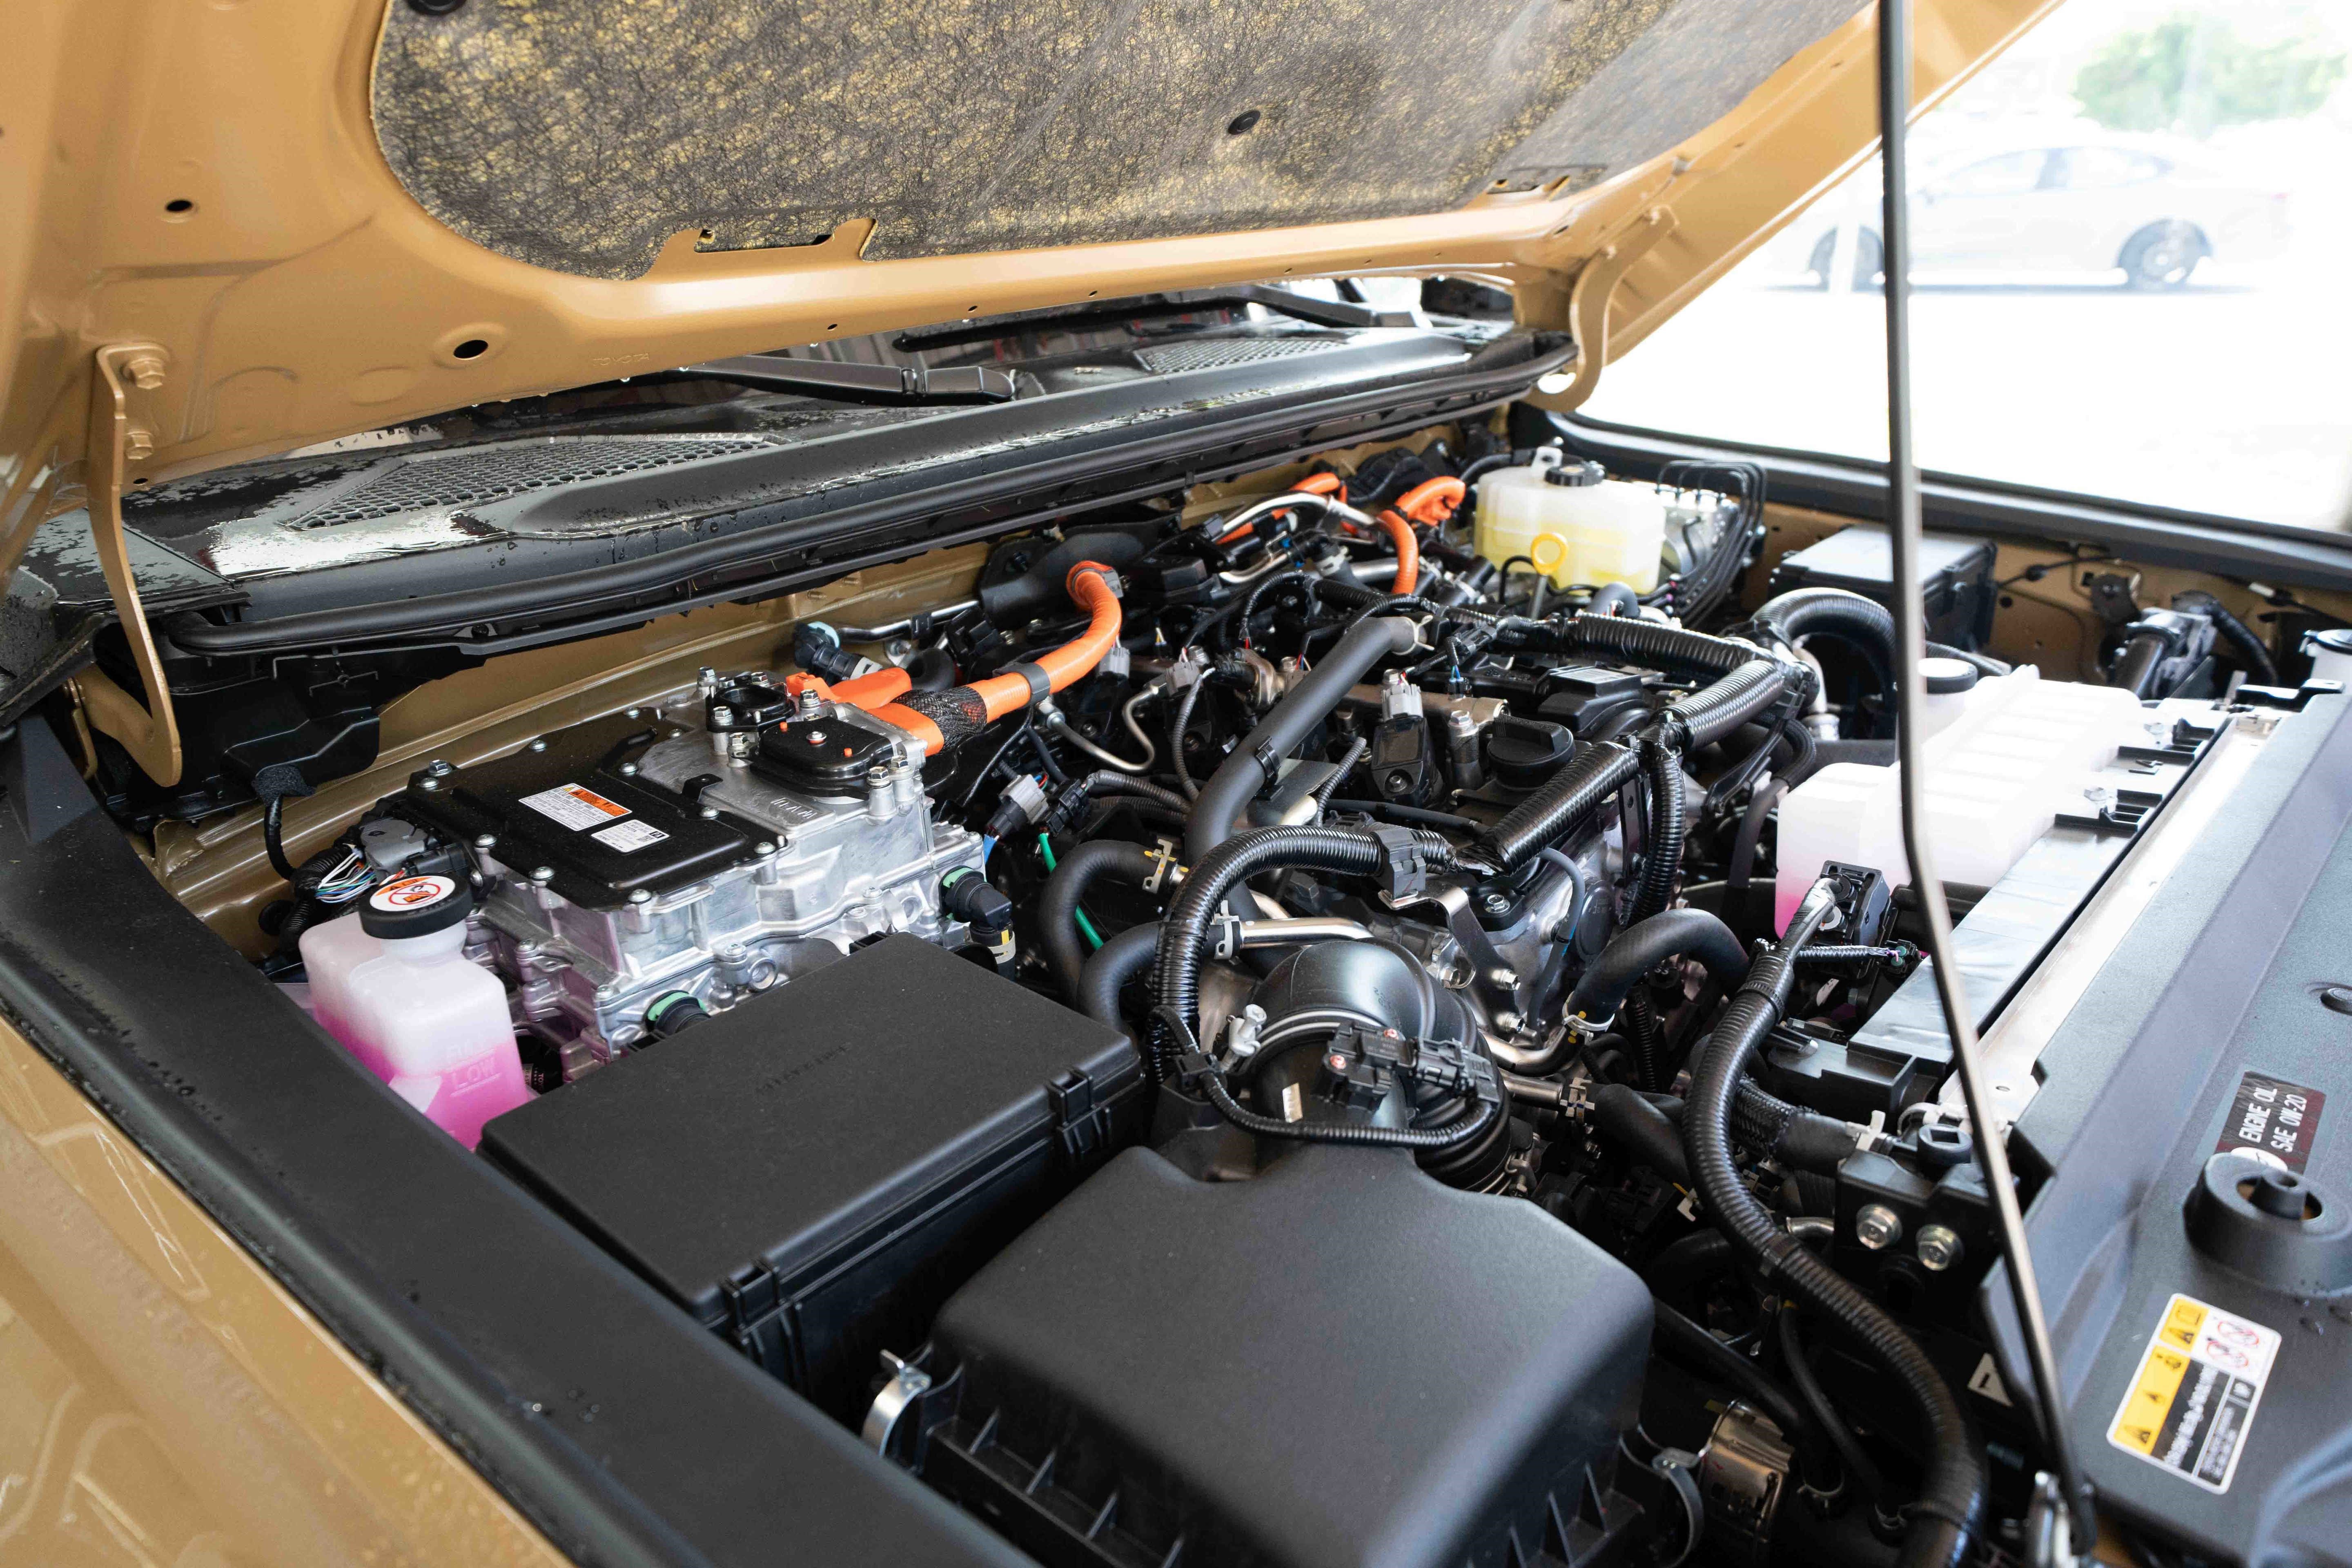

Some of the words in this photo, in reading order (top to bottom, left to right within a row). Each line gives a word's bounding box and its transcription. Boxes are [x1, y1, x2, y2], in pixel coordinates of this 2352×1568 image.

[451, 1057, 494, 1089] LOW
[2253, 1087, 2278, 1102] OIL
[2238, 1102, 2271, 1143] ENGINE
[2270, 1126, 2297, 1152] SAE
